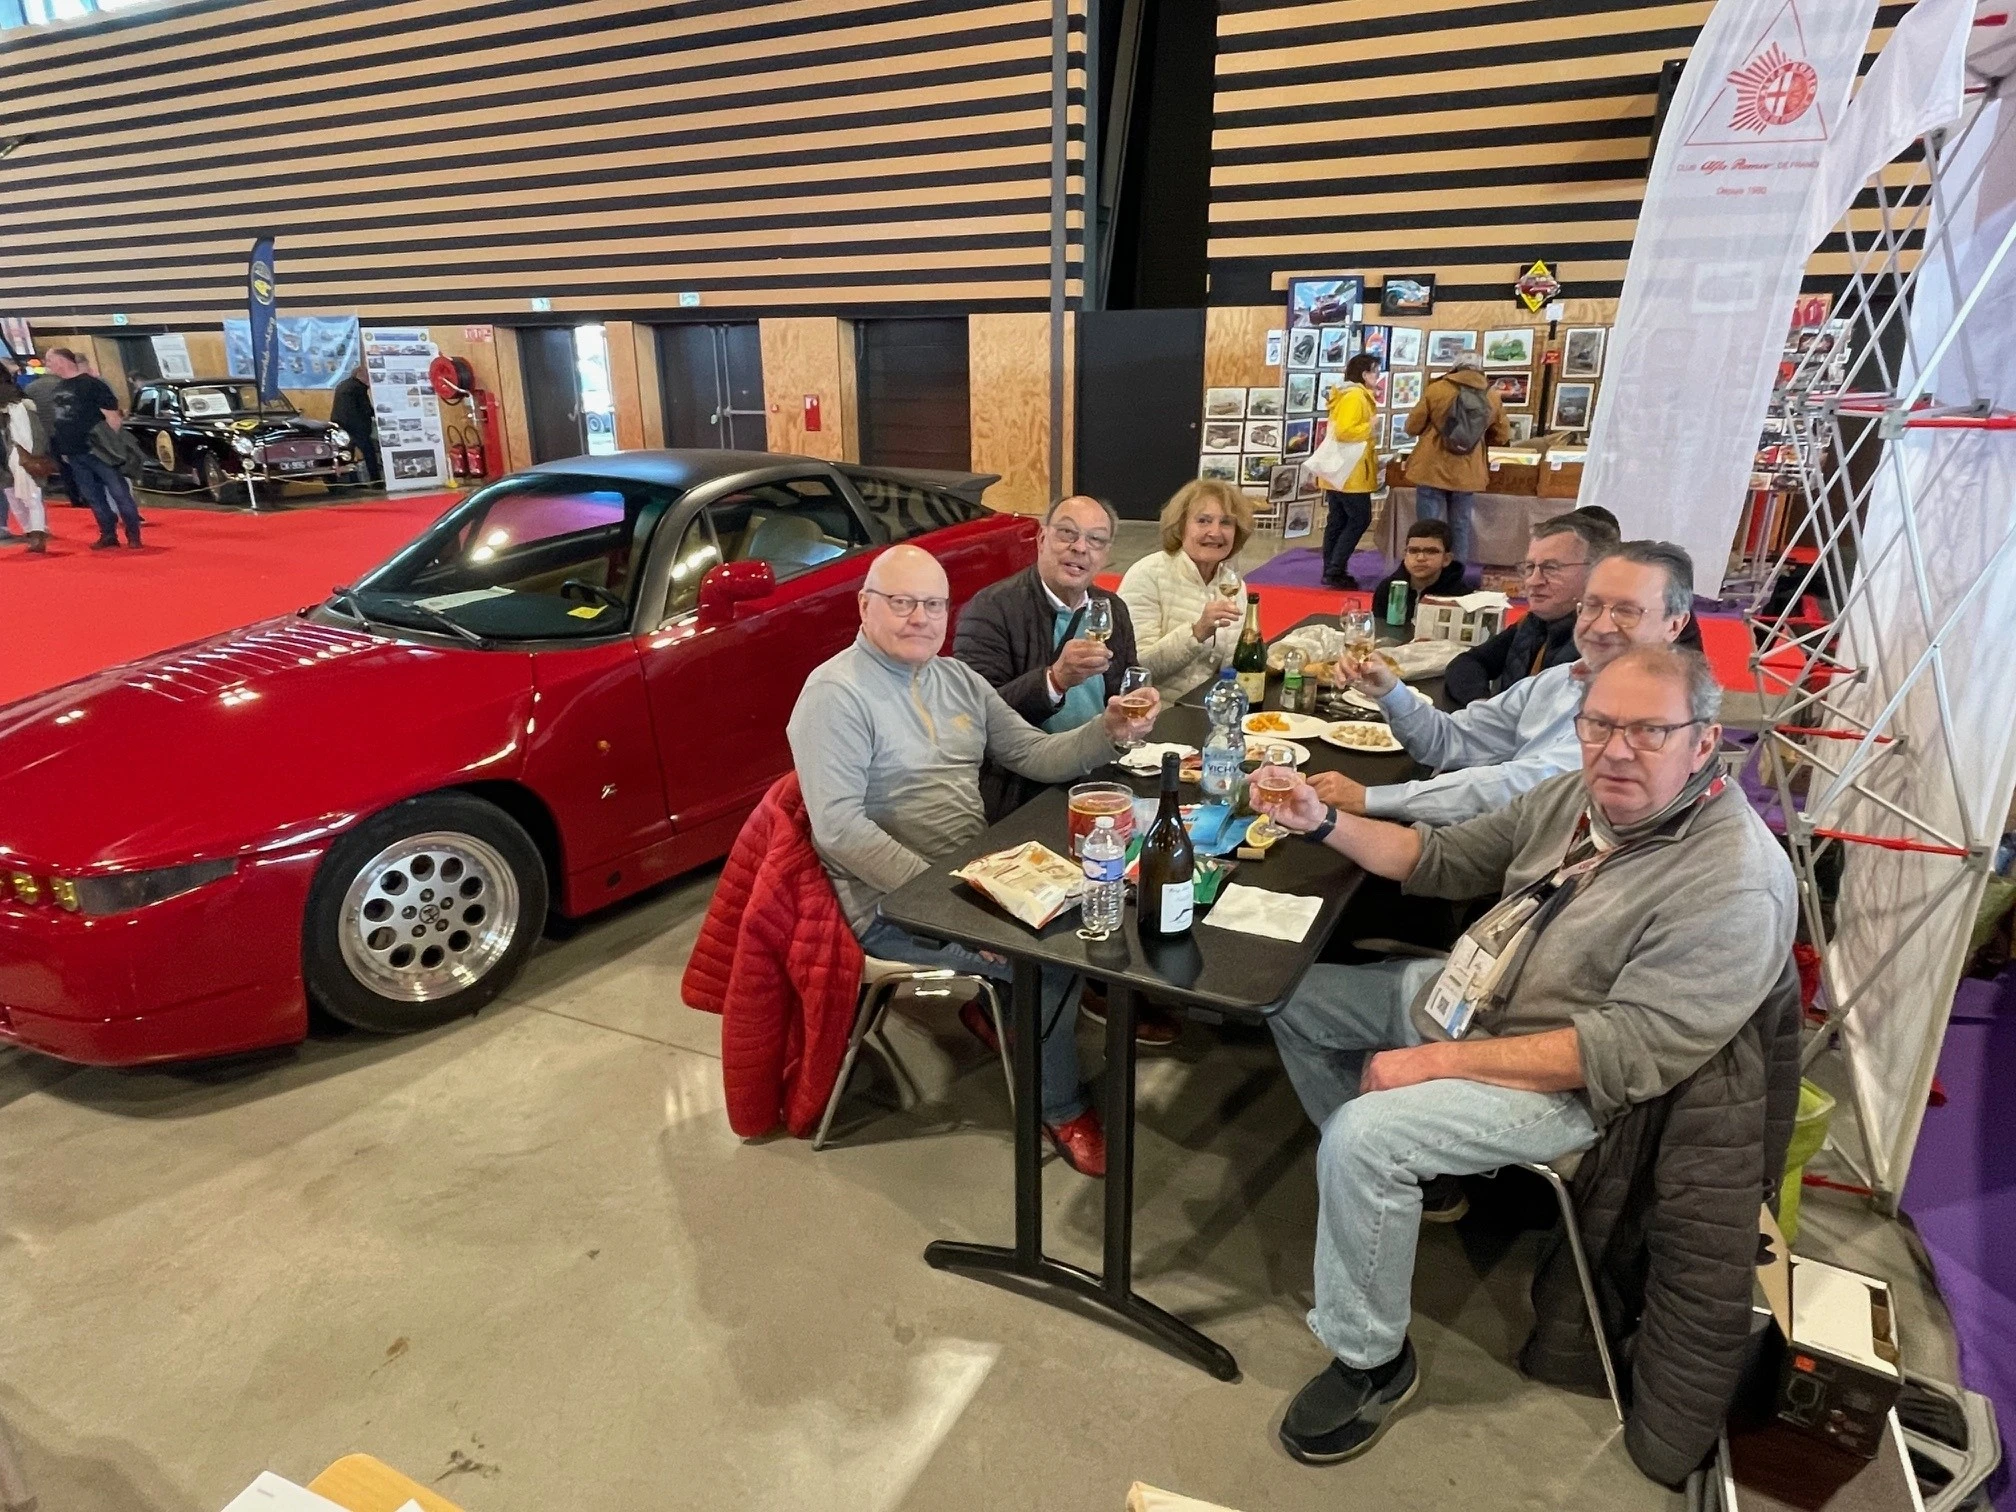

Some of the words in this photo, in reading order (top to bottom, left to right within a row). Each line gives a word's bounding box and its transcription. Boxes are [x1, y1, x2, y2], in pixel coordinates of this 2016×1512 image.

[1700, 159, 1727, 175] Alfa
[1731, 157, 1774, 170] Romeo
[1208, 763, 1237, 774] VICHY
